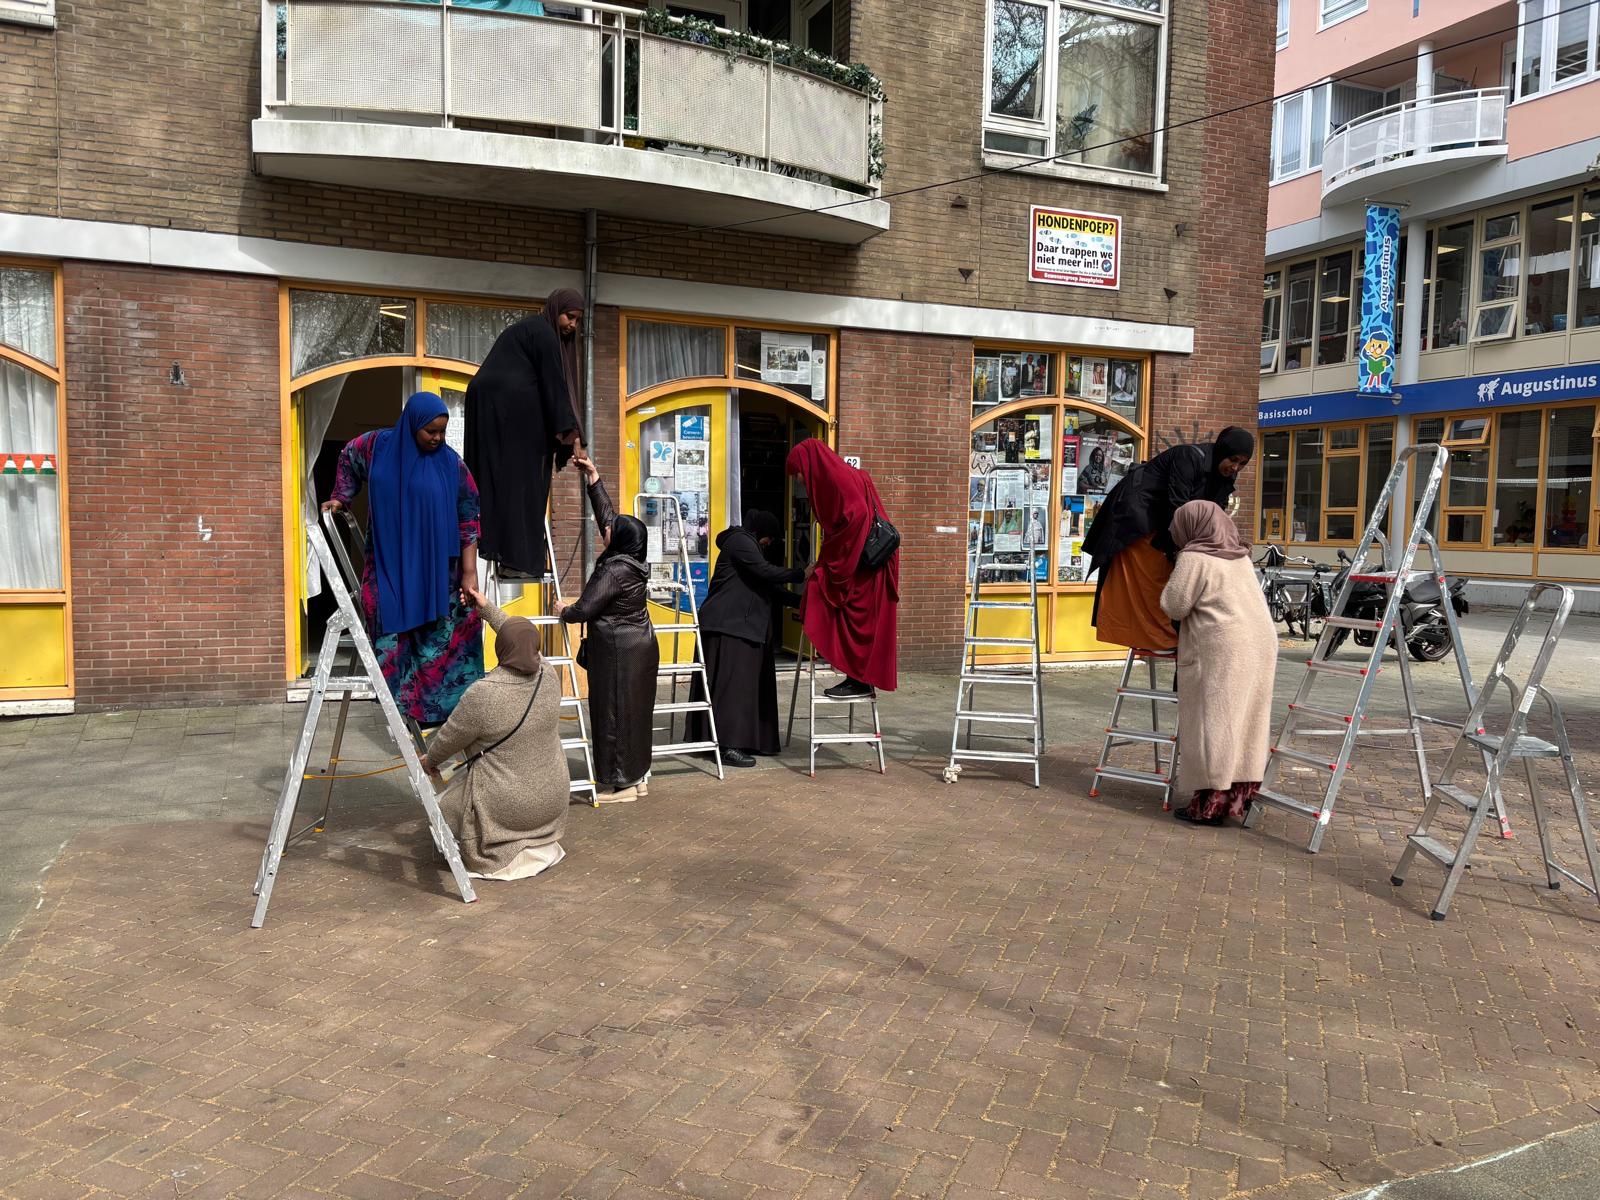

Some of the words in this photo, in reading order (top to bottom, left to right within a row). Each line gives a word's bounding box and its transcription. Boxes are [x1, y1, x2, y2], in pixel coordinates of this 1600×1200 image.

[1038, 214, 1114, 235] HONDENPOEP?
[1037, 242, 1059, 253] Daar
[1062, 246, 1098, 259] trappen
[1100, 251, 1113, 260] we
[1037, 254, 1055, 265] niet
[1058, 257, 1082, 268] meer
[1083, 259, 1099, 269] in!!
[1380, 236, 1391, 312] Augustinus
[1500, 375, 1598, 397] Augustinus
[1258, 405, 1312, 420] Basisschool
[847, 458, 858, 468] 62
